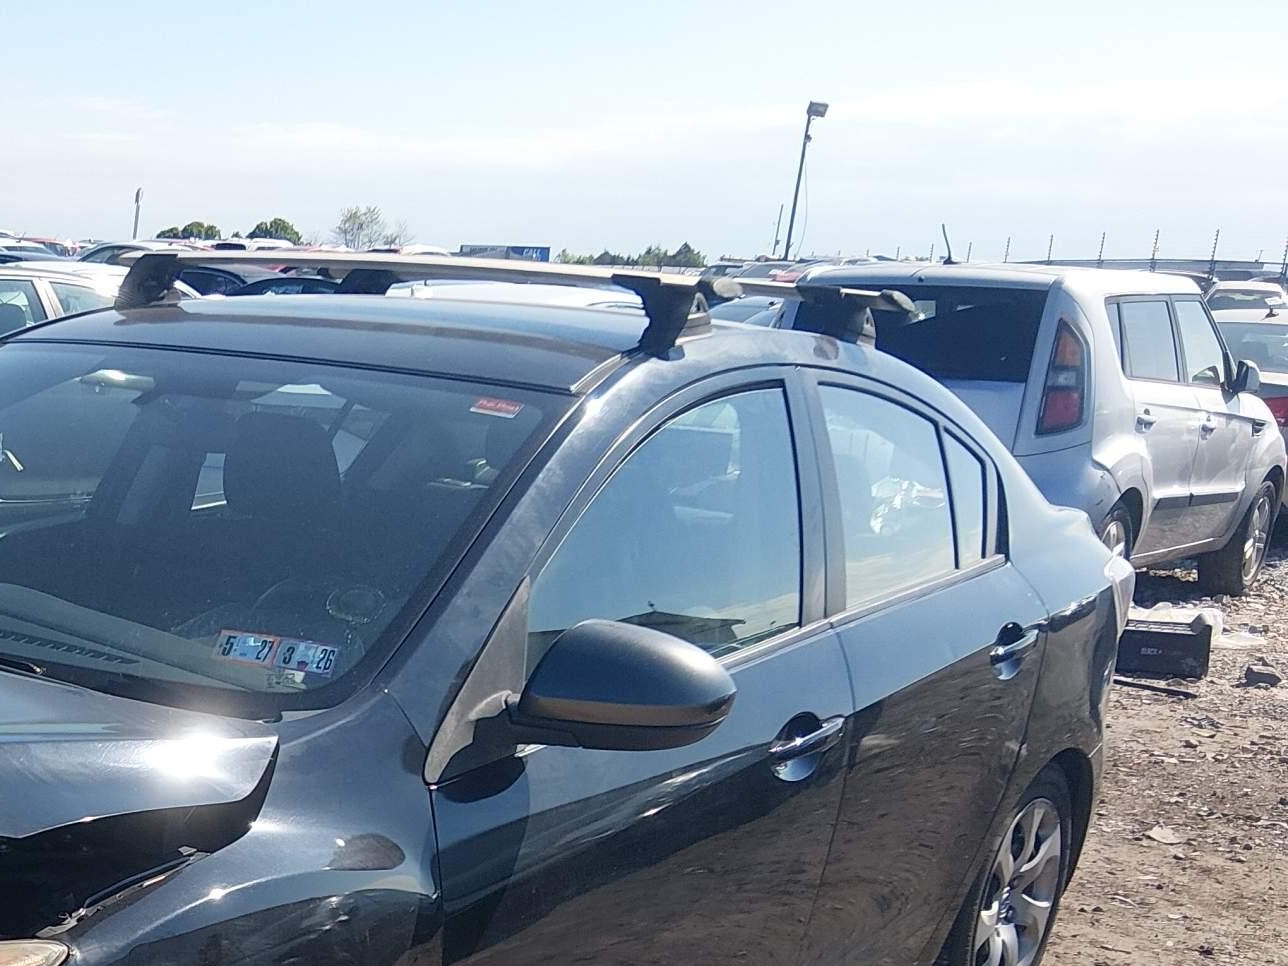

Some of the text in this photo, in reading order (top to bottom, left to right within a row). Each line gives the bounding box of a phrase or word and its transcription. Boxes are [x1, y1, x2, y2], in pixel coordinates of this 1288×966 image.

[222, 635, 237, 657] 5
[255, 639, 275, 662] 27
[282, 646, 295, 665] 3
[315, 648, 335, 671] 26
